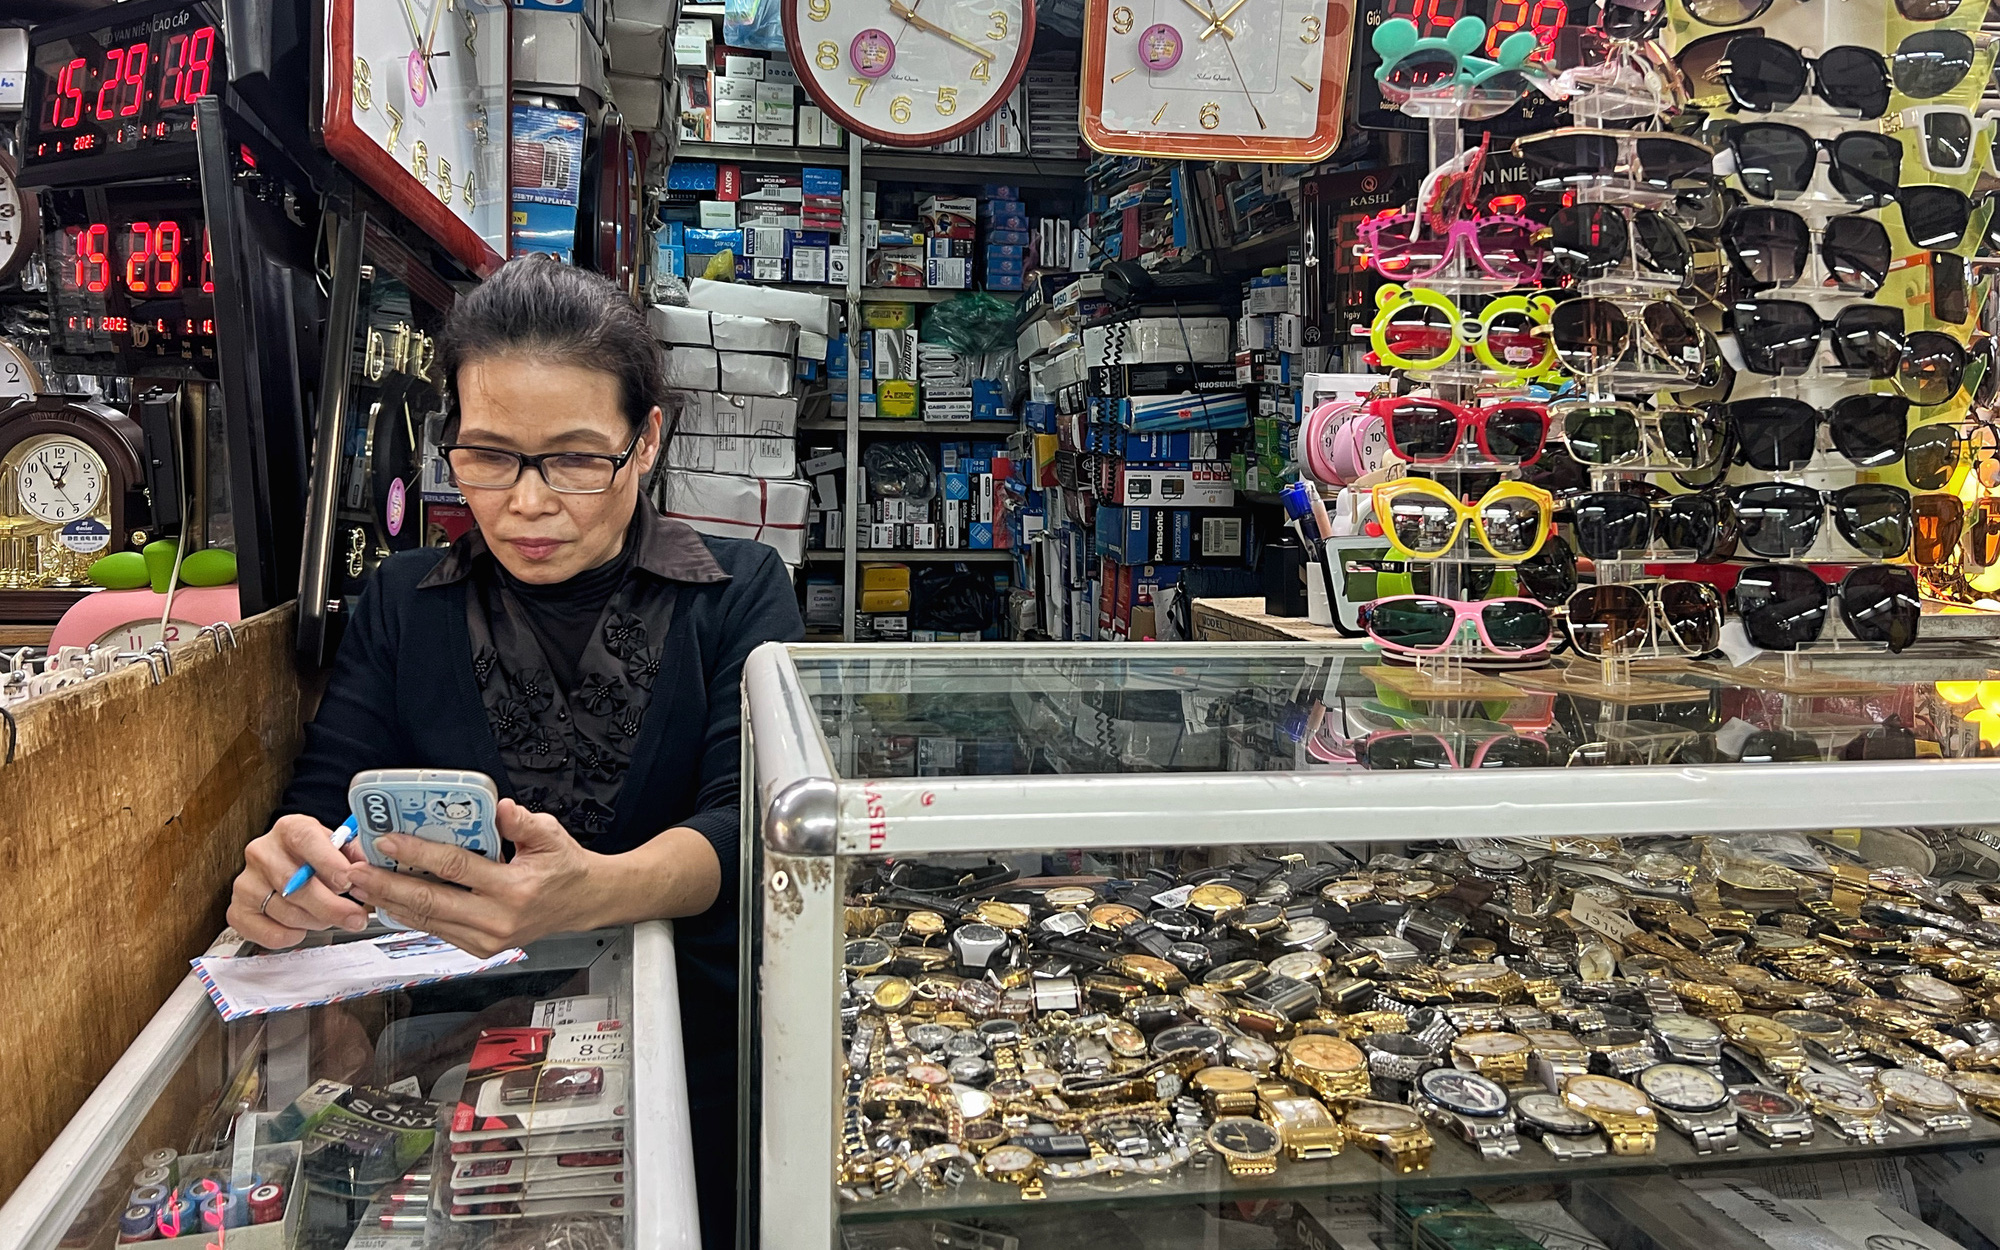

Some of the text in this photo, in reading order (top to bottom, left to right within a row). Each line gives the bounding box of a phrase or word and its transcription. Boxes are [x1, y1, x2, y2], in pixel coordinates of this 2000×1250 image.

[153, 17, 171, 32] CAO
[172, 10, 190, 28] CẤP
[808, 0, 831, 22] 9
[1112, 6, 1135, 35] 9
[986, 11, 1008, 40] 3
[1300, 15, 1321, 44] 3
[815, 40, 839, 71] 8
[970, 58, 991, 86] 4
[354, 56, 371, 111] 8
[848, 77, 872, 107] 7
[889, 95, 913, 124] 6
[935, 86, 957, 116] 5
[1199, 101, 1221, 130] 6
[386, 102, 403, 154] 7
[412, 139, 429, 187] 6
[438, 156, 452, 204] 5
[463, 170, 475, 215] 4
[535, 194, 547, 203] MP3
[547, 195, 572, 206] PLAYER
[1350, 193, 1389, 206] KASHI
[1053, 292, 1067, 308] CASIO
[905, 334, 914, 377] Energizer
[6, 362, 20, 384] 2
[1330, 424, 1340, 435] 10
[1370, 432, 1381, 442] 10
[54, 448, 65, 458] 12
[1325, 437, 1332, 448] 9
[1365, 446, 1372, 455] 9
[27, 463, 38, 473] 10
[1370, 461, 1376, 470] 8
[24, 477, 32, 488] 9
[88, 478, 95, 488] 3
[29, 492, 37, 503] 8
[41, 503, 48, 513] 7
[84, 492, 92, 503] 4
[57, 507, 64, 518] 6
[1154, 510, 1164, 562] Panasonic
[129, 636, 142, 650] 11
[349, 1099, 438, 1127] SONY
